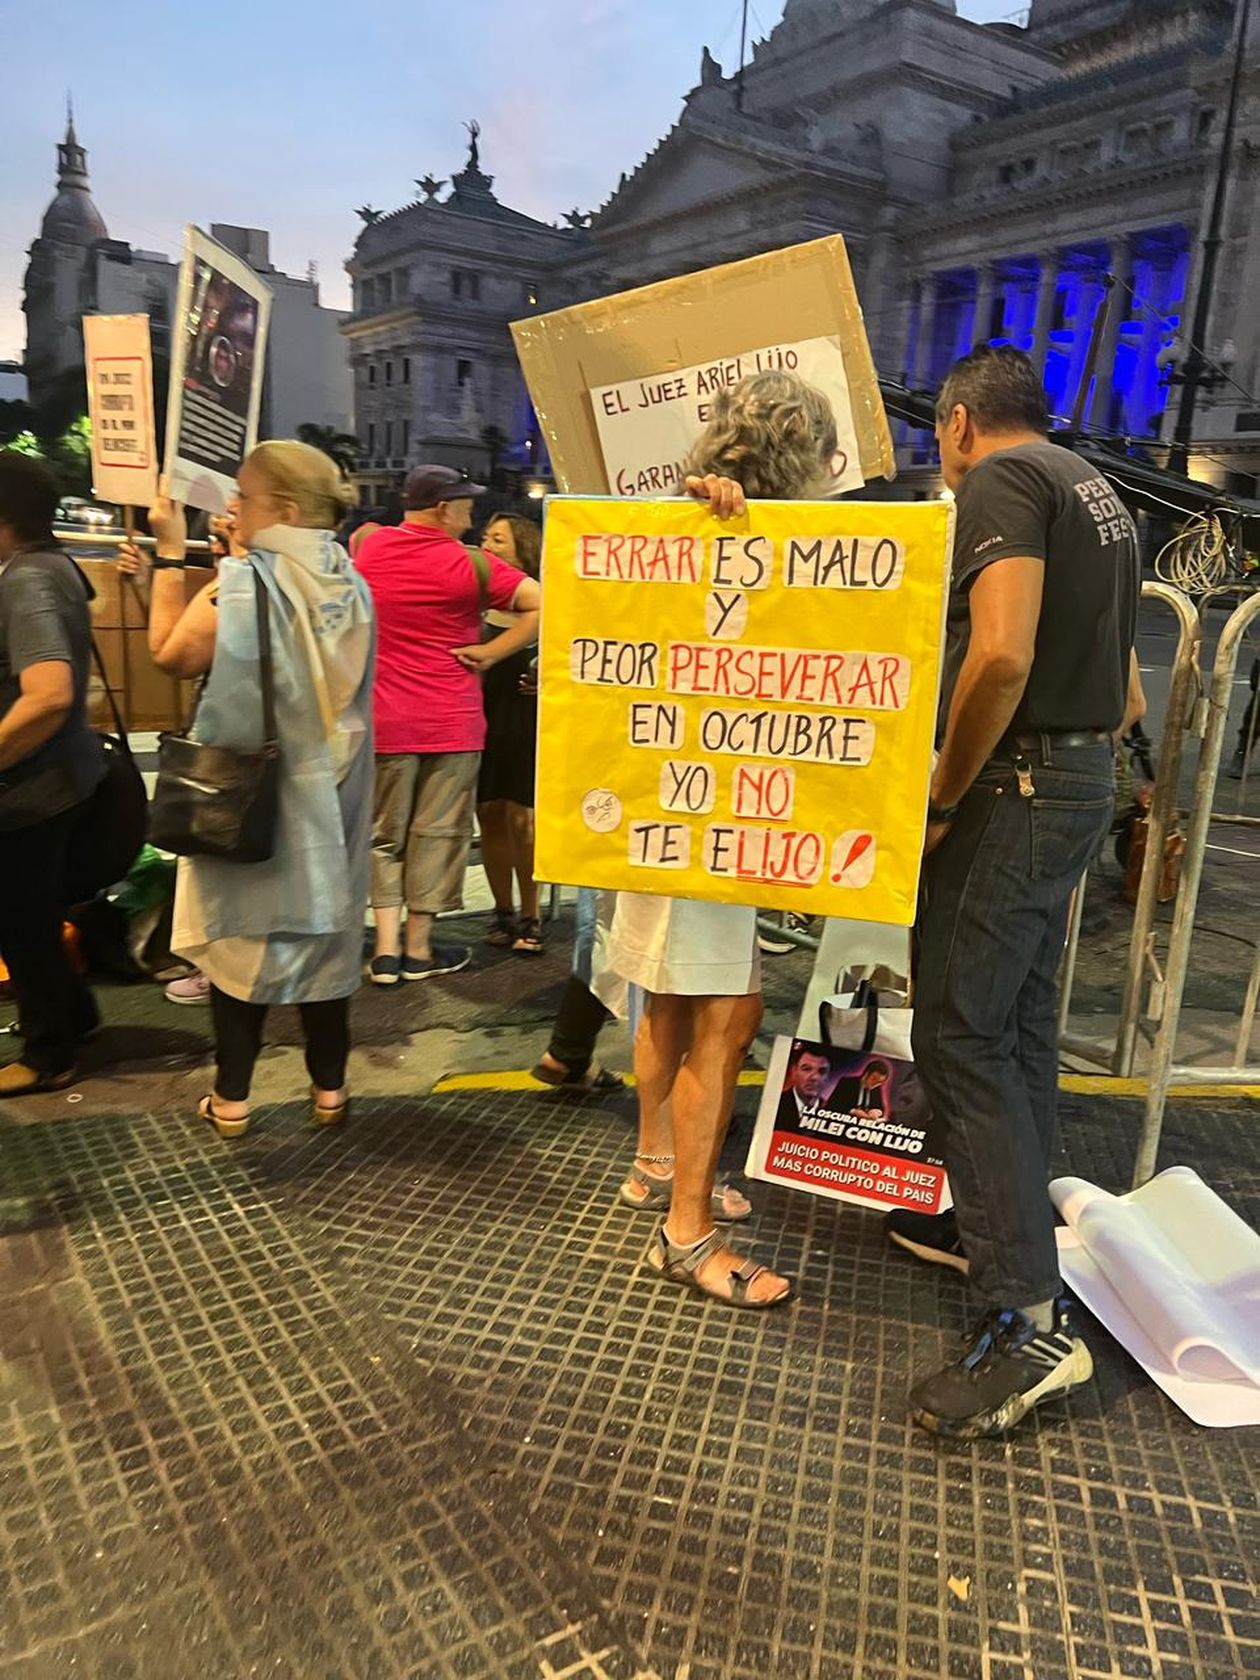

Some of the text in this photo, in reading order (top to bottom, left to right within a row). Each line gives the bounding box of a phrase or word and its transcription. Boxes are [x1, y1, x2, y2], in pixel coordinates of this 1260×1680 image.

[602, 389, 630, 416] EL
[638, 378, 688, 408] JUEZ
[581, 534, 898, 588] ERRAR ES MALO
[712, 591, 742, 637] Y
[573, 638, 900, 709] PEOR PERSEVERAR
[632, 703, 867, 762] EN OCTUBRE
[668, 761, 790, 818] YO NO
[633, 824, 684, 863] TE
[798, 1115, 923, 1154] MILEI CON LIJO
[802, 1105, 927, 1141] LA OSCURA RELACIÓN DE
[772, 1156, 935, 1205] MAS CORRUPTO DEL PAIS
[777, 1141, 937, 1188] JUICIO POLITICO AL JUEZ
